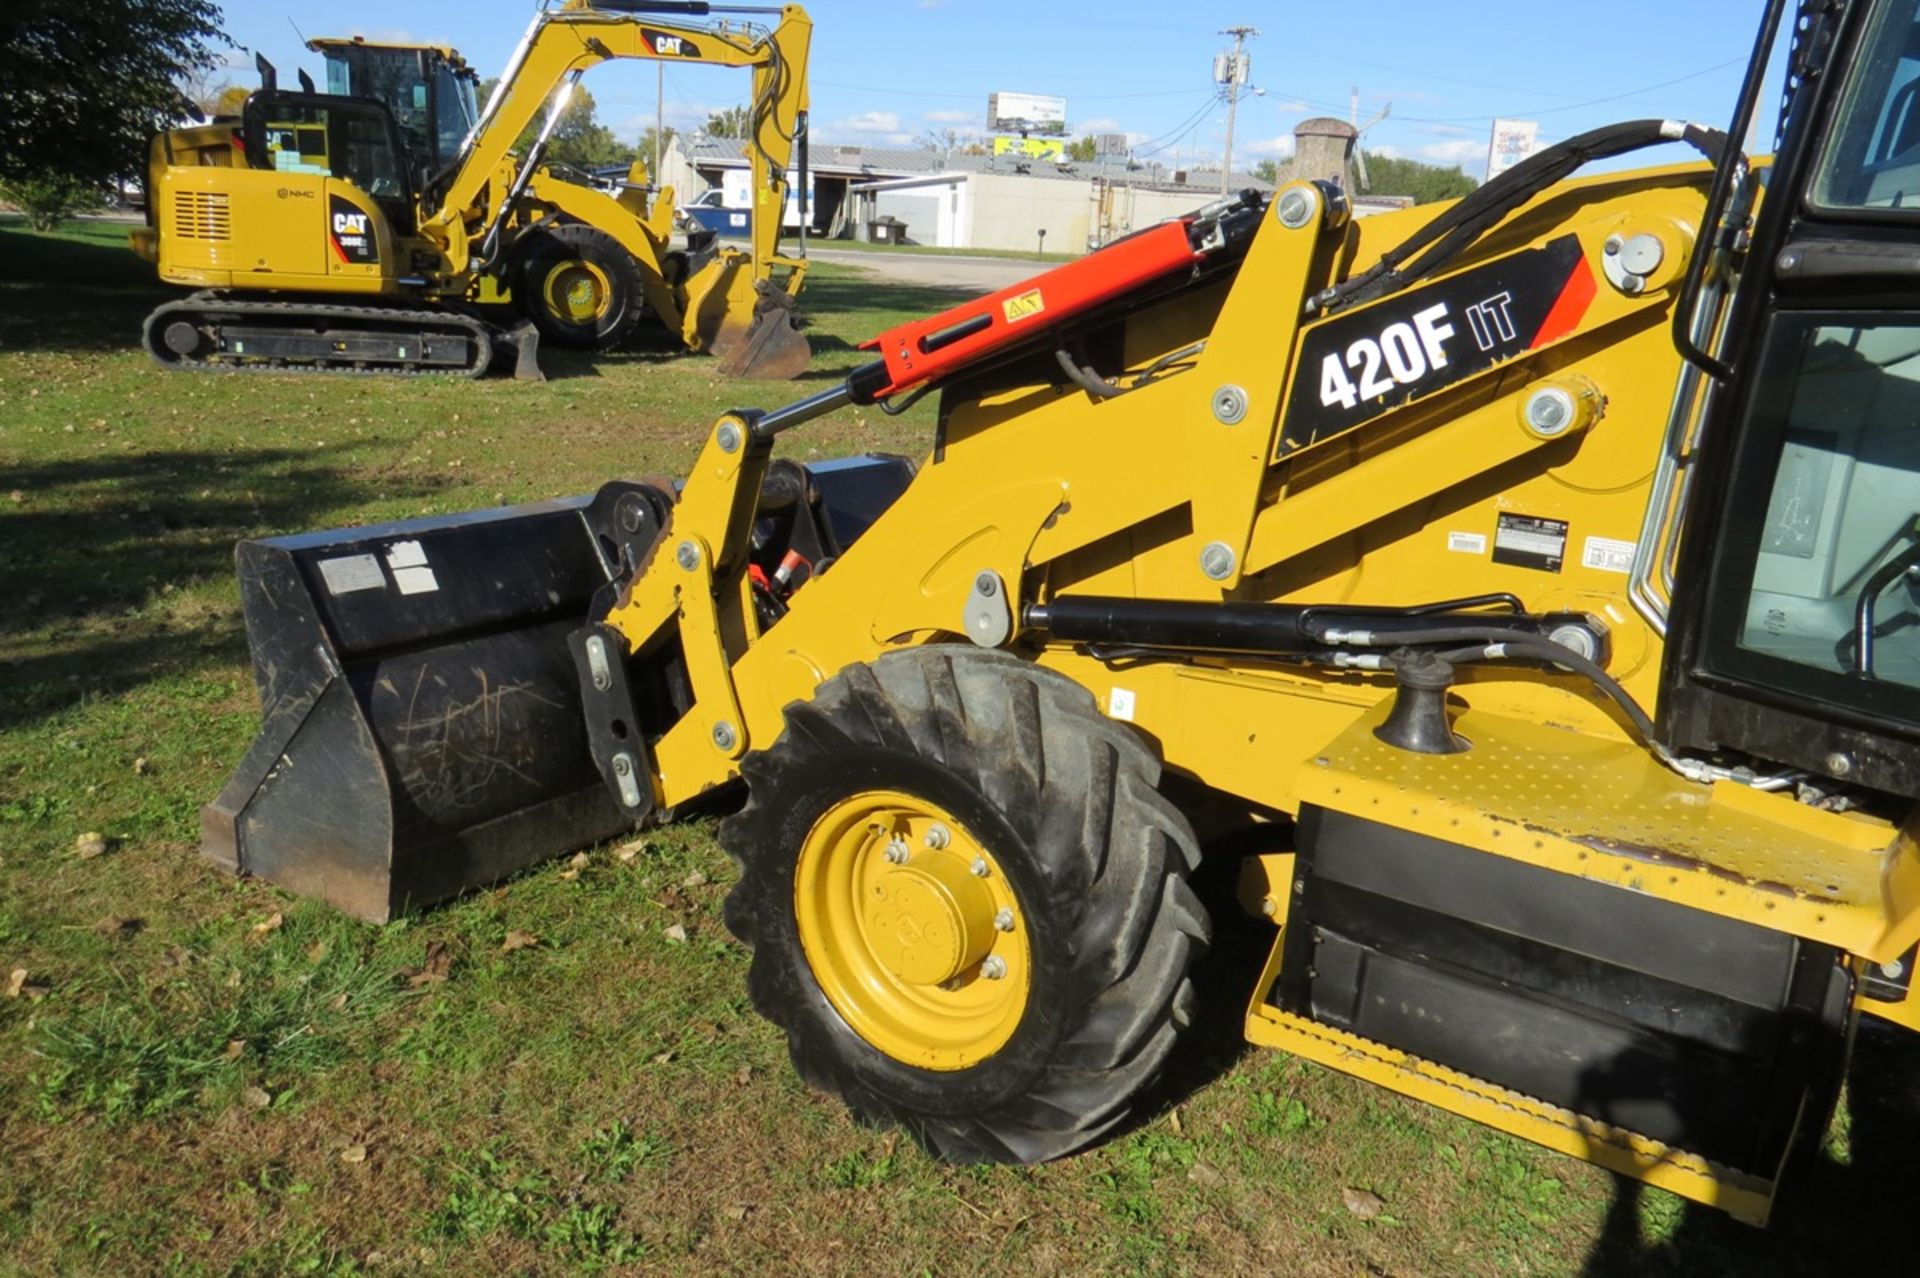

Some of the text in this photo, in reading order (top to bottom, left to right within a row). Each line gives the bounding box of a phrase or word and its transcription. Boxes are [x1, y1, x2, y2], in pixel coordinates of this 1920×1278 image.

[656, 36, 682, 55] CAT
[289, 190, 314, 198] NMC
[333, 212, 367, 234] CAT
[1320, 291, 1516, 410] 420F IT
